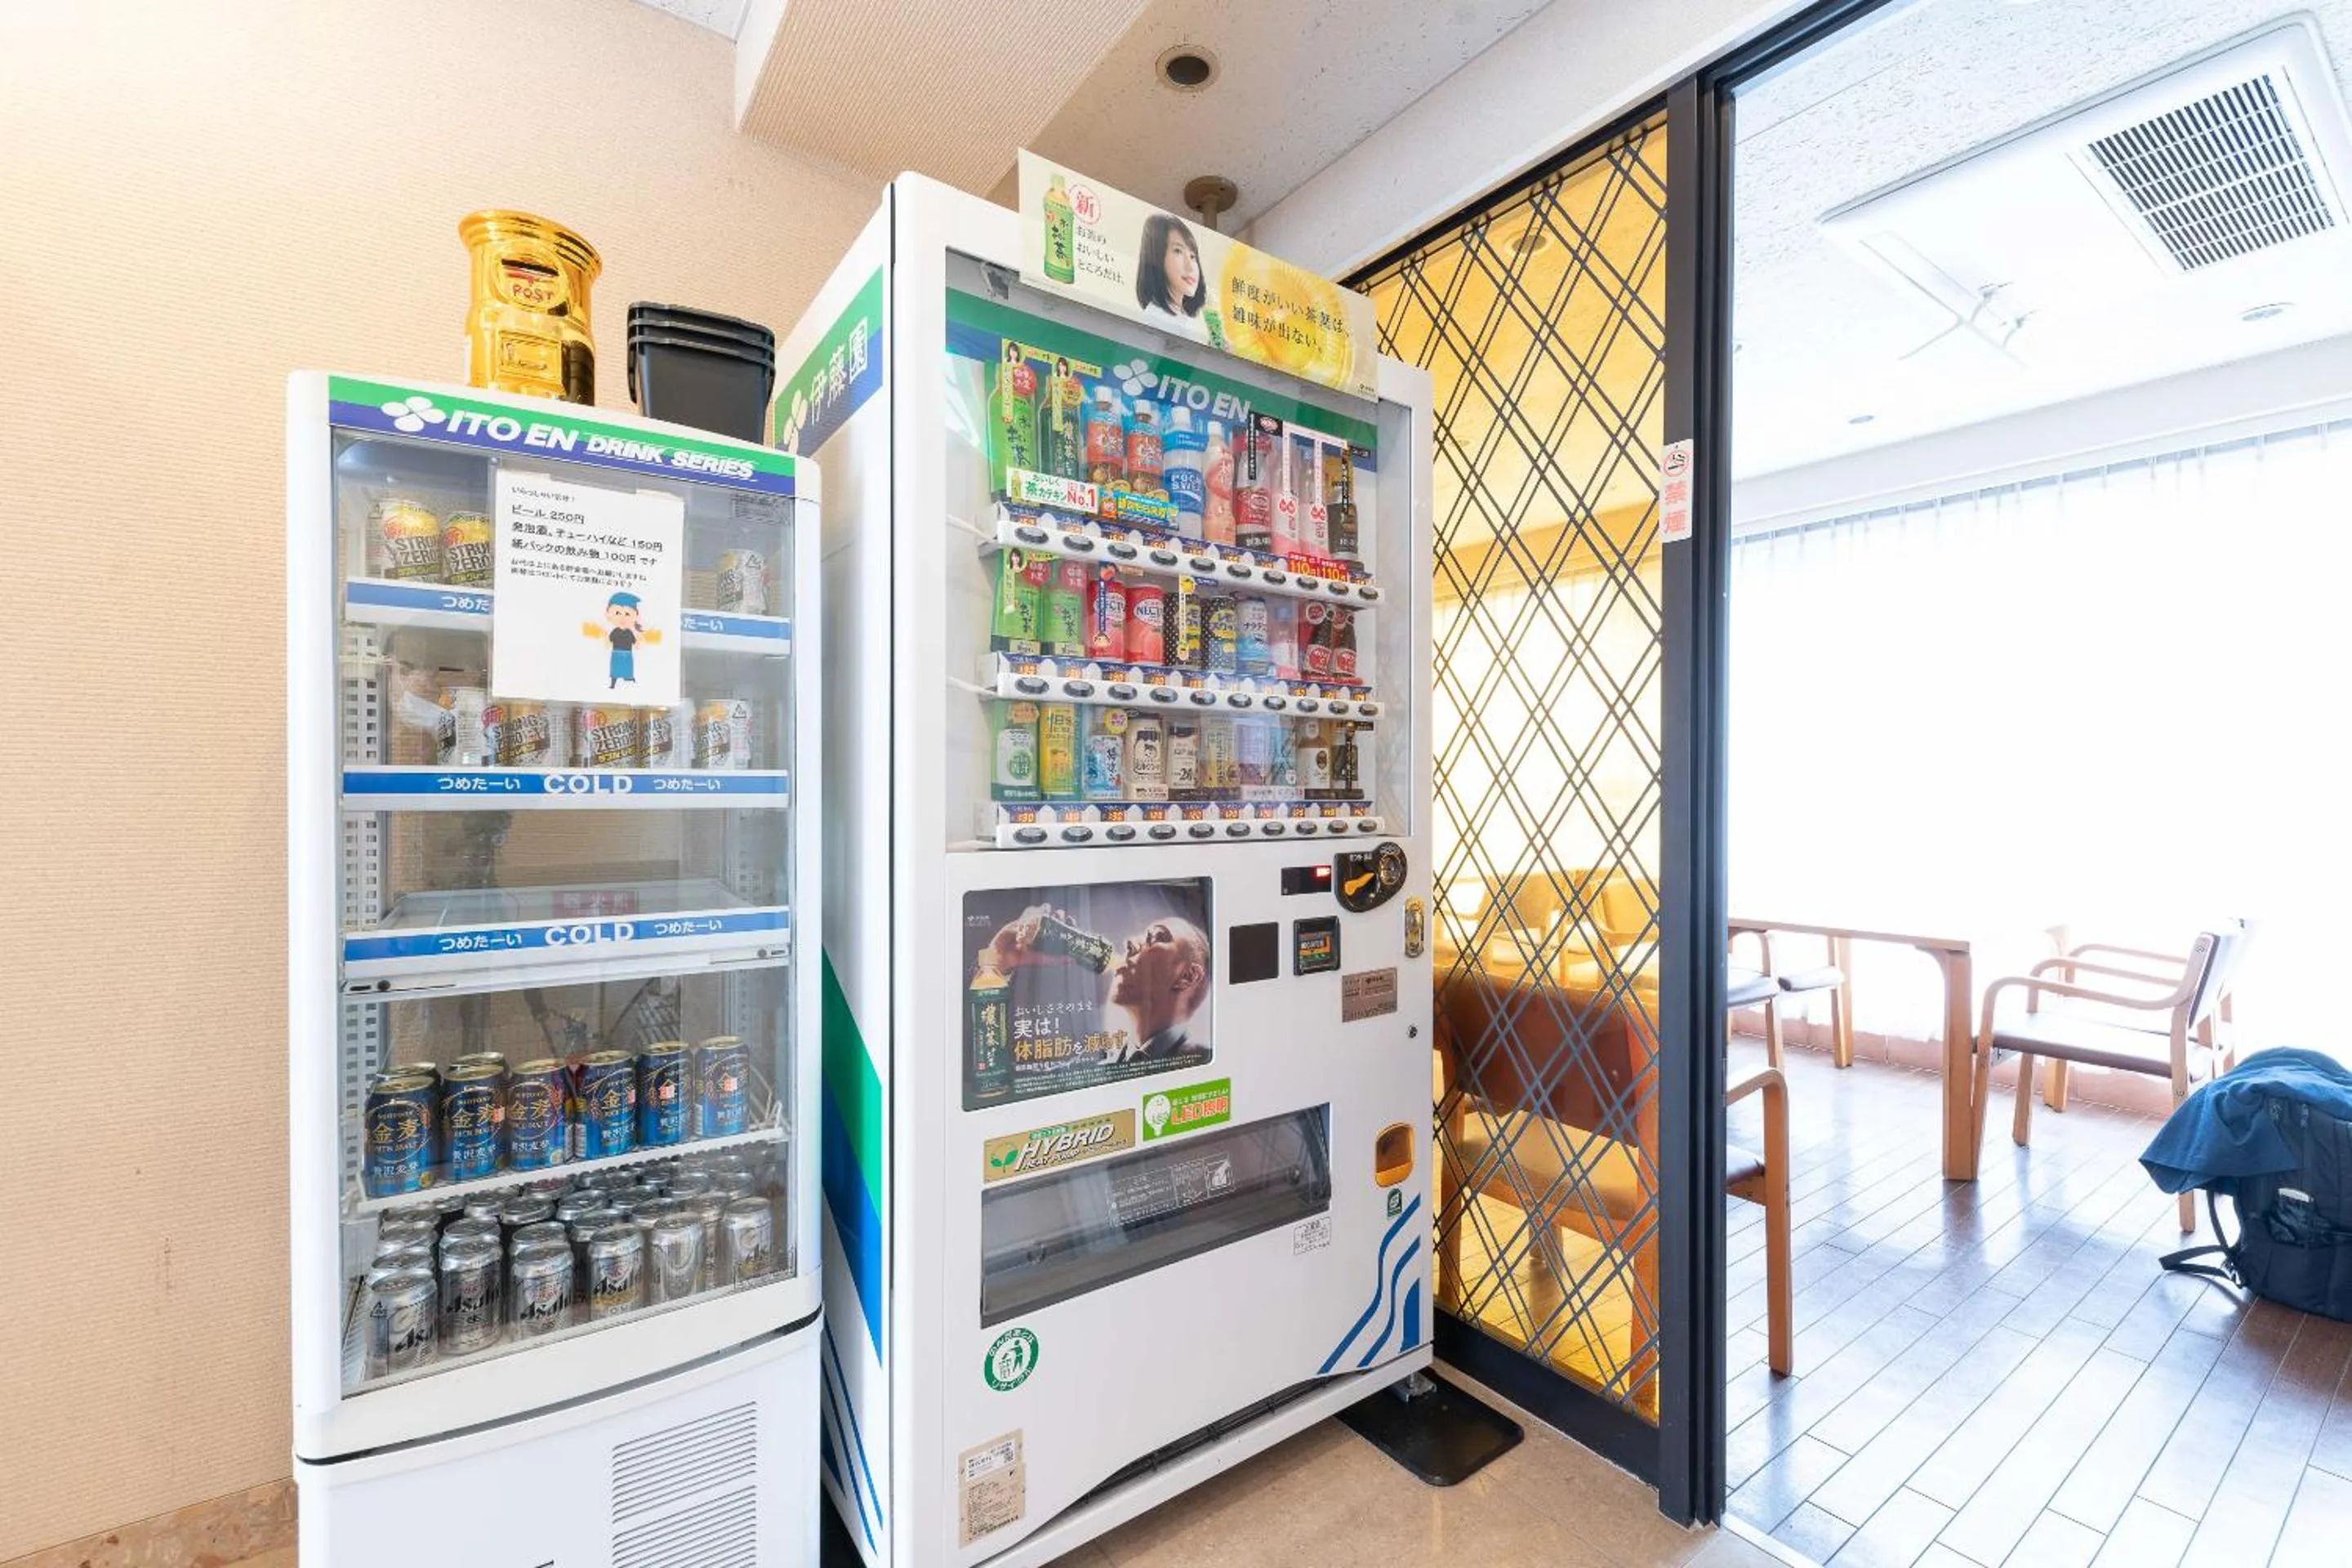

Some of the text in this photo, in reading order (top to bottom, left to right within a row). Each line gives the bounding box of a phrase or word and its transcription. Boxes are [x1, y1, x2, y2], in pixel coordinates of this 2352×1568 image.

[1076, 190, 1095, 219] 新
[1077, 243, 1115, 263] おいしい
[512, 283, 555, 304] POST
[809, 317, 868, 426] 伊藤園
[1157, 375, 1251, 423] ITO EN
[446, 410, 579, 451] ITO EN
[586, 435, 755, 479] DRINK SERIES
[1067, 488, 1096, 508] No.1
[512, 504, 585, 524] ビール 250円
[511, 537, 658, 566] 紙パックの飲み物 100円 です
[632, 539, 663, 552] 150円
[442, 596, 490, 612] つめた
[437, 774, 721, 794] つめたーい COLD つめたーい
[438, 919, 723, 951] つめたーい COLD つめたーい
[1013, 1030, 1128, 1061] 体脂肪を減らす
[372, 1118, 420, 1143] 金麦
[1014, 1123, 1116, 1171] HYBRID
